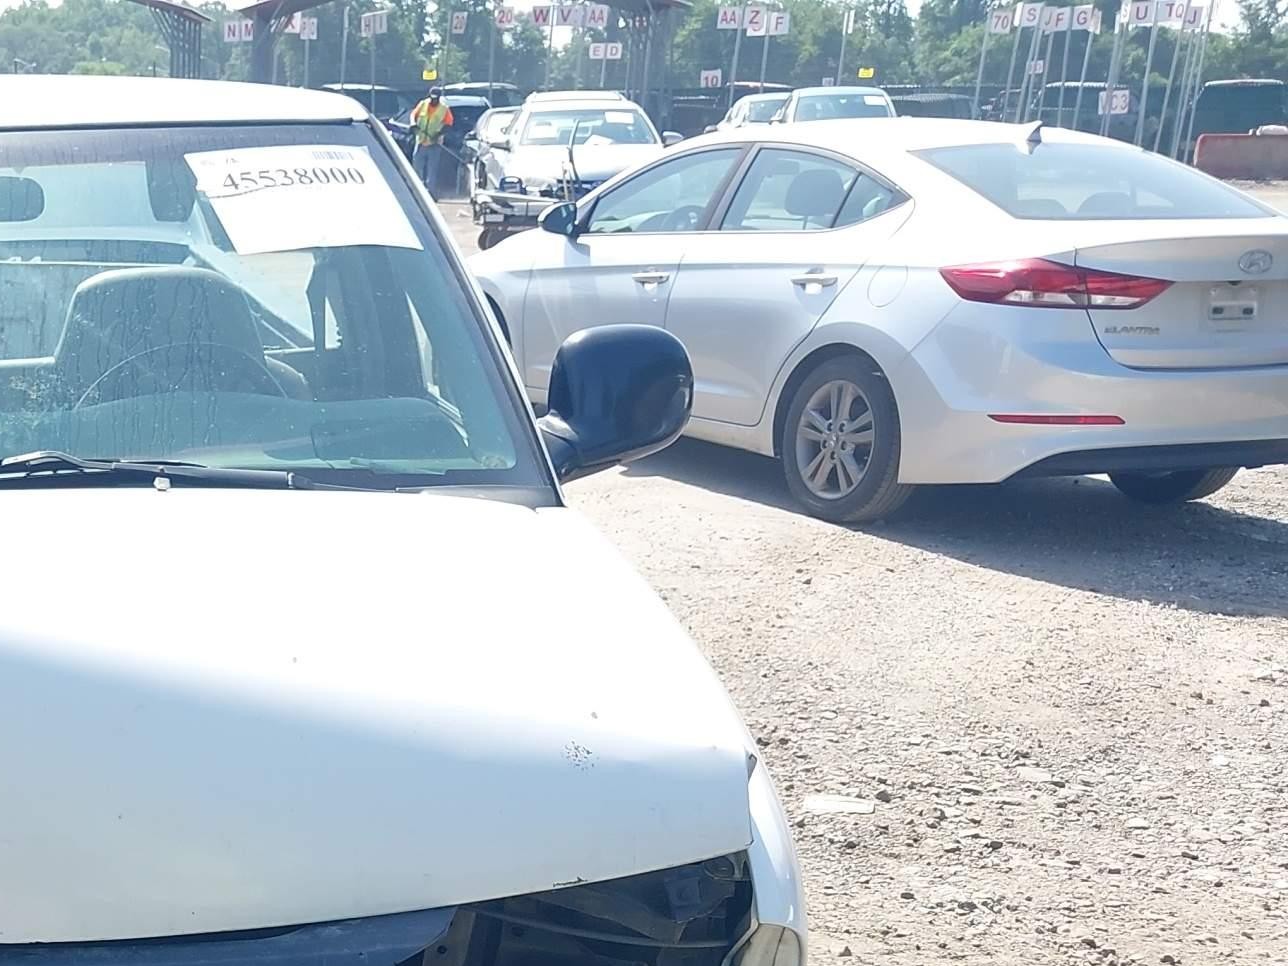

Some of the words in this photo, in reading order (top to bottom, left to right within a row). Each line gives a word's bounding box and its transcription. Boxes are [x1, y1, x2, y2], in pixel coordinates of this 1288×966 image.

[498, 10, 512, 24] 20
[533, 8, 550, 23] W
[560, 9, 572, 22] V
[588, 9, 605, 23] AA
[719, 11, 737, 25] AA
[748, 10, 760, 25] Z
[1026, 7, 1037, 22] S
[1076, 10, 1088, 25] G
[1135, 5, 1149, 20] U
[1165, 3, 1175, 18] T
[1175, 3, 1185, 19] Q
[1187, 9, 1197, 25] J
[454, 15, 465, 30] 20
[774, 16, 785, 31] F
[993, 15, 1008, 31] 70
[1044, 12, 1052, 26] J
[1055, 12, 1065, 27] F
[227, 24, 236, 38] N
[592, 46, 601, 57] E
[610, 46, 619, 56] D
[704, 74, 718, 88] 10
[223, 167, 366, 190] 45538000
